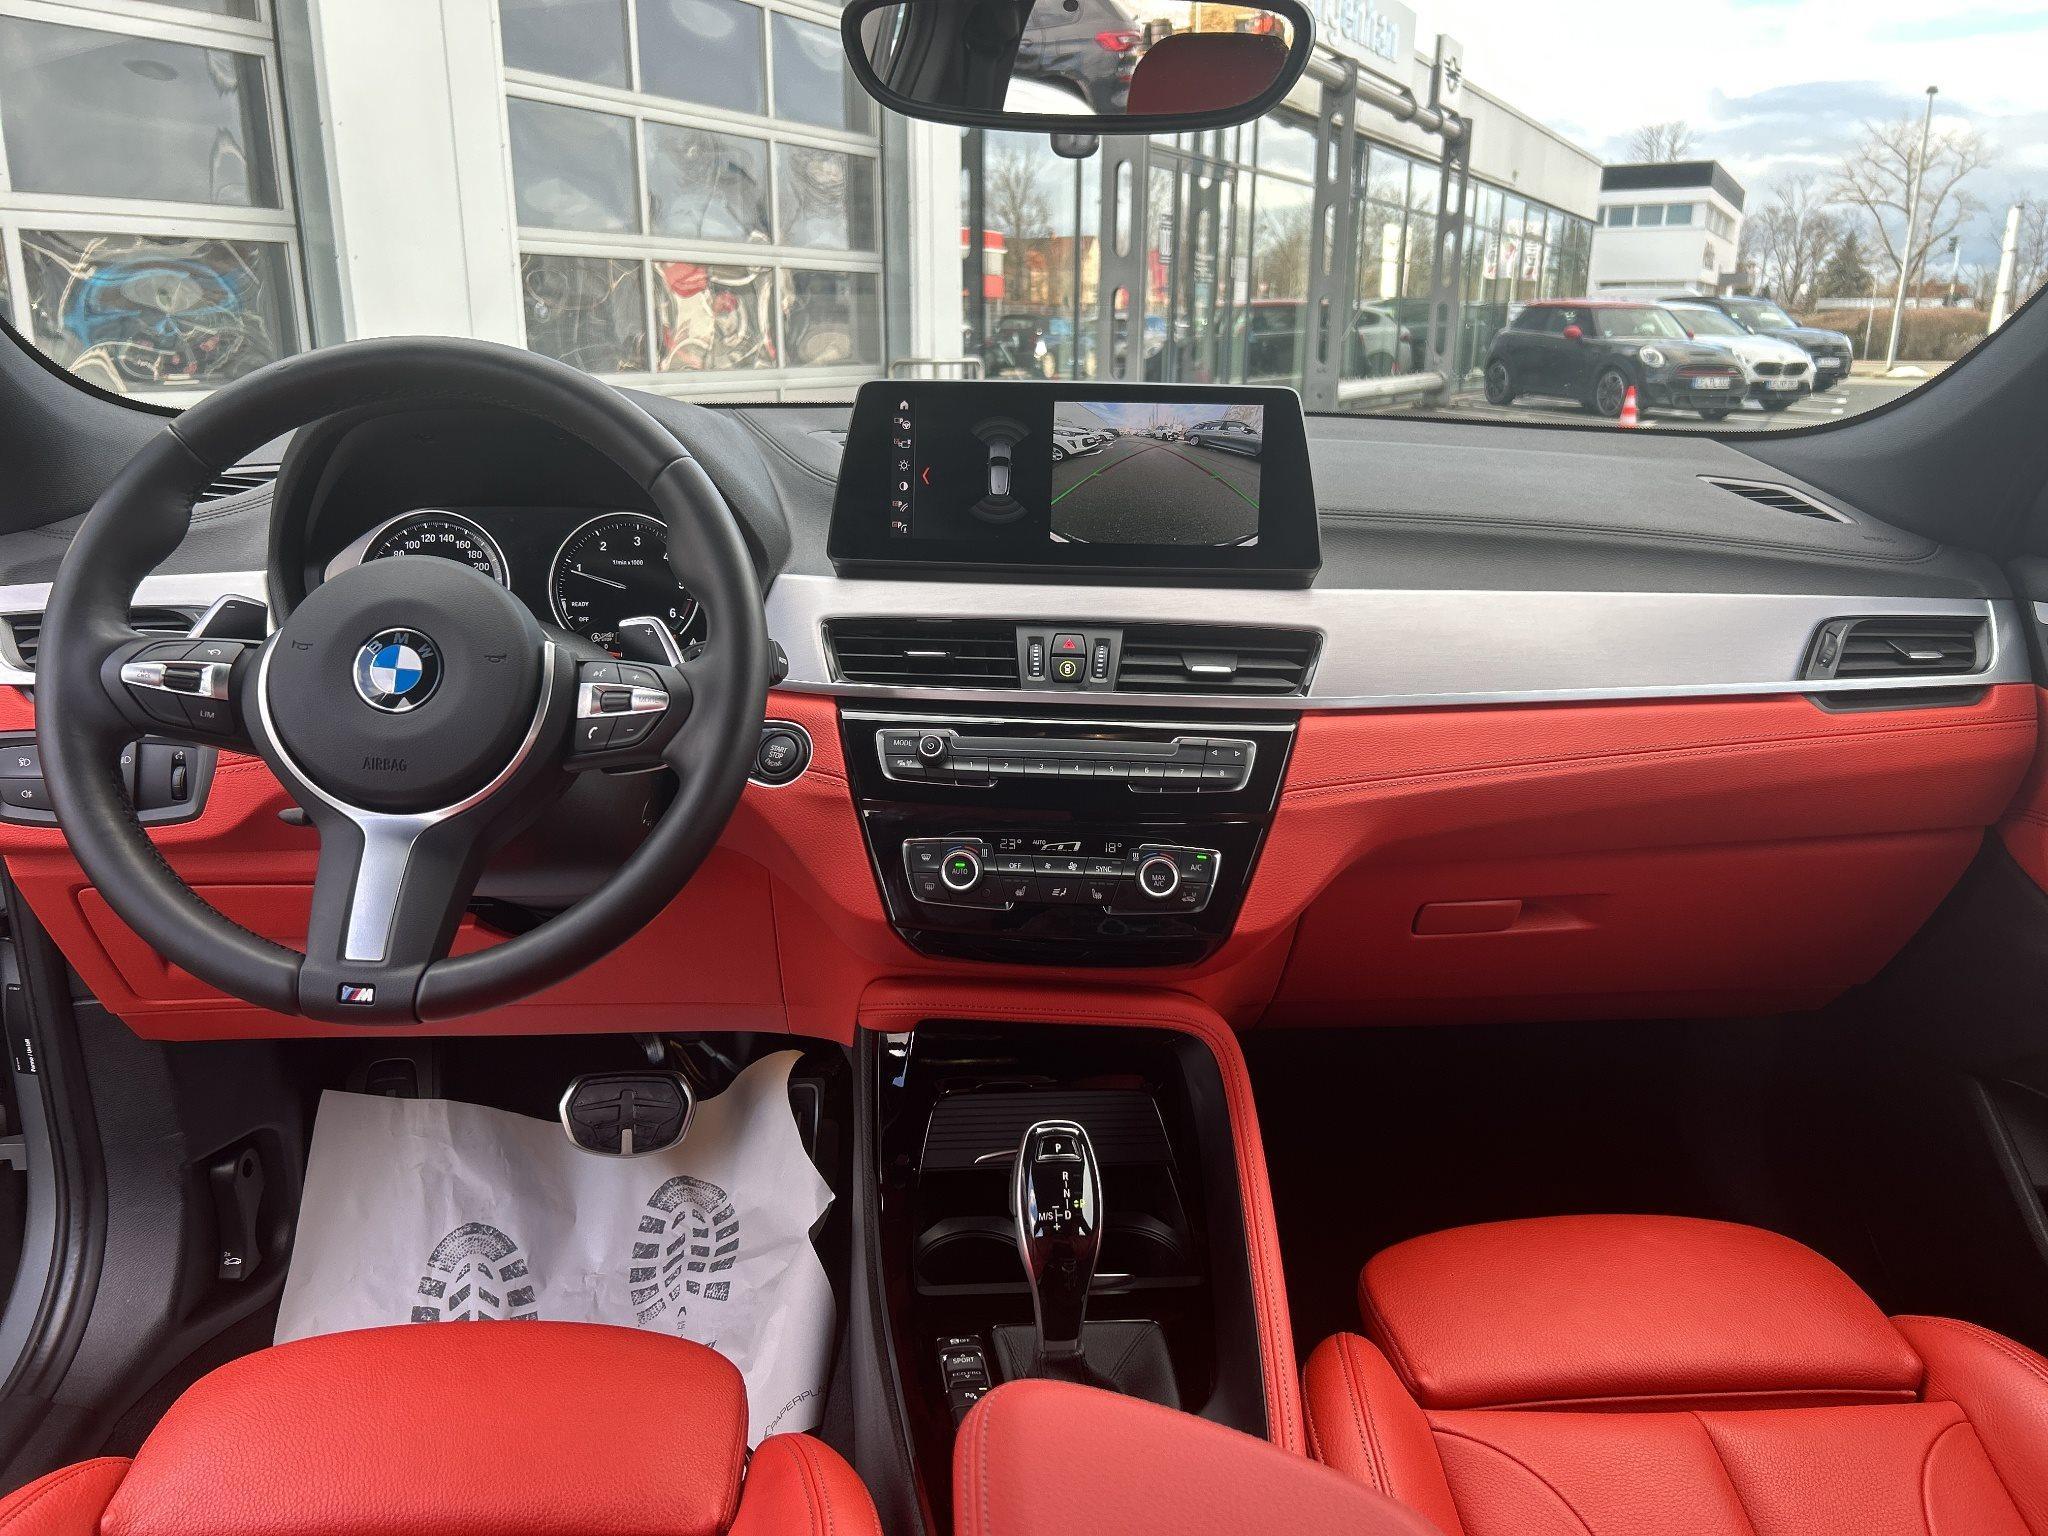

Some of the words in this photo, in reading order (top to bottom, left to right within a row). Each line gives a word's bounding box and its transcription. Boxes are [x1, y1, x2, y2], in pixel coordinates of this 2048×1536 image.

[421, 534, 436, 543] 120
[439, 534, 455, 543] 140
[633, 536, 641, 546] 3
[405, 540, 421, 549] 100
[455, 540, 471, 549] 160
[600, 542, 607, 551] 2
[467, 550, 483, 559] 180
[576, 563, 582, 572] 1
[669, 608, 677, 617] 6
[366, 632, 435, 660] BMW
[200, 710, 216, 719] LIM
[893, 739, 913, 747] MODE
[769, 744, 789, 754] START
[768, 750, 784, 760] STOP
[361, 756, 408, 772] AIRBAG
[1095, 865, 1113, 873] SYNC
[1055, 1143, 1062, 1153] P
[1062, 1171, 1069, 1181] R
[1063, 1188, 1071, 1198] N
[1038, 1211, 1054, 1221] M/S
[1064, 1210, 1072, 1220] D
[952, 1356, 974, 1365] SPORT
